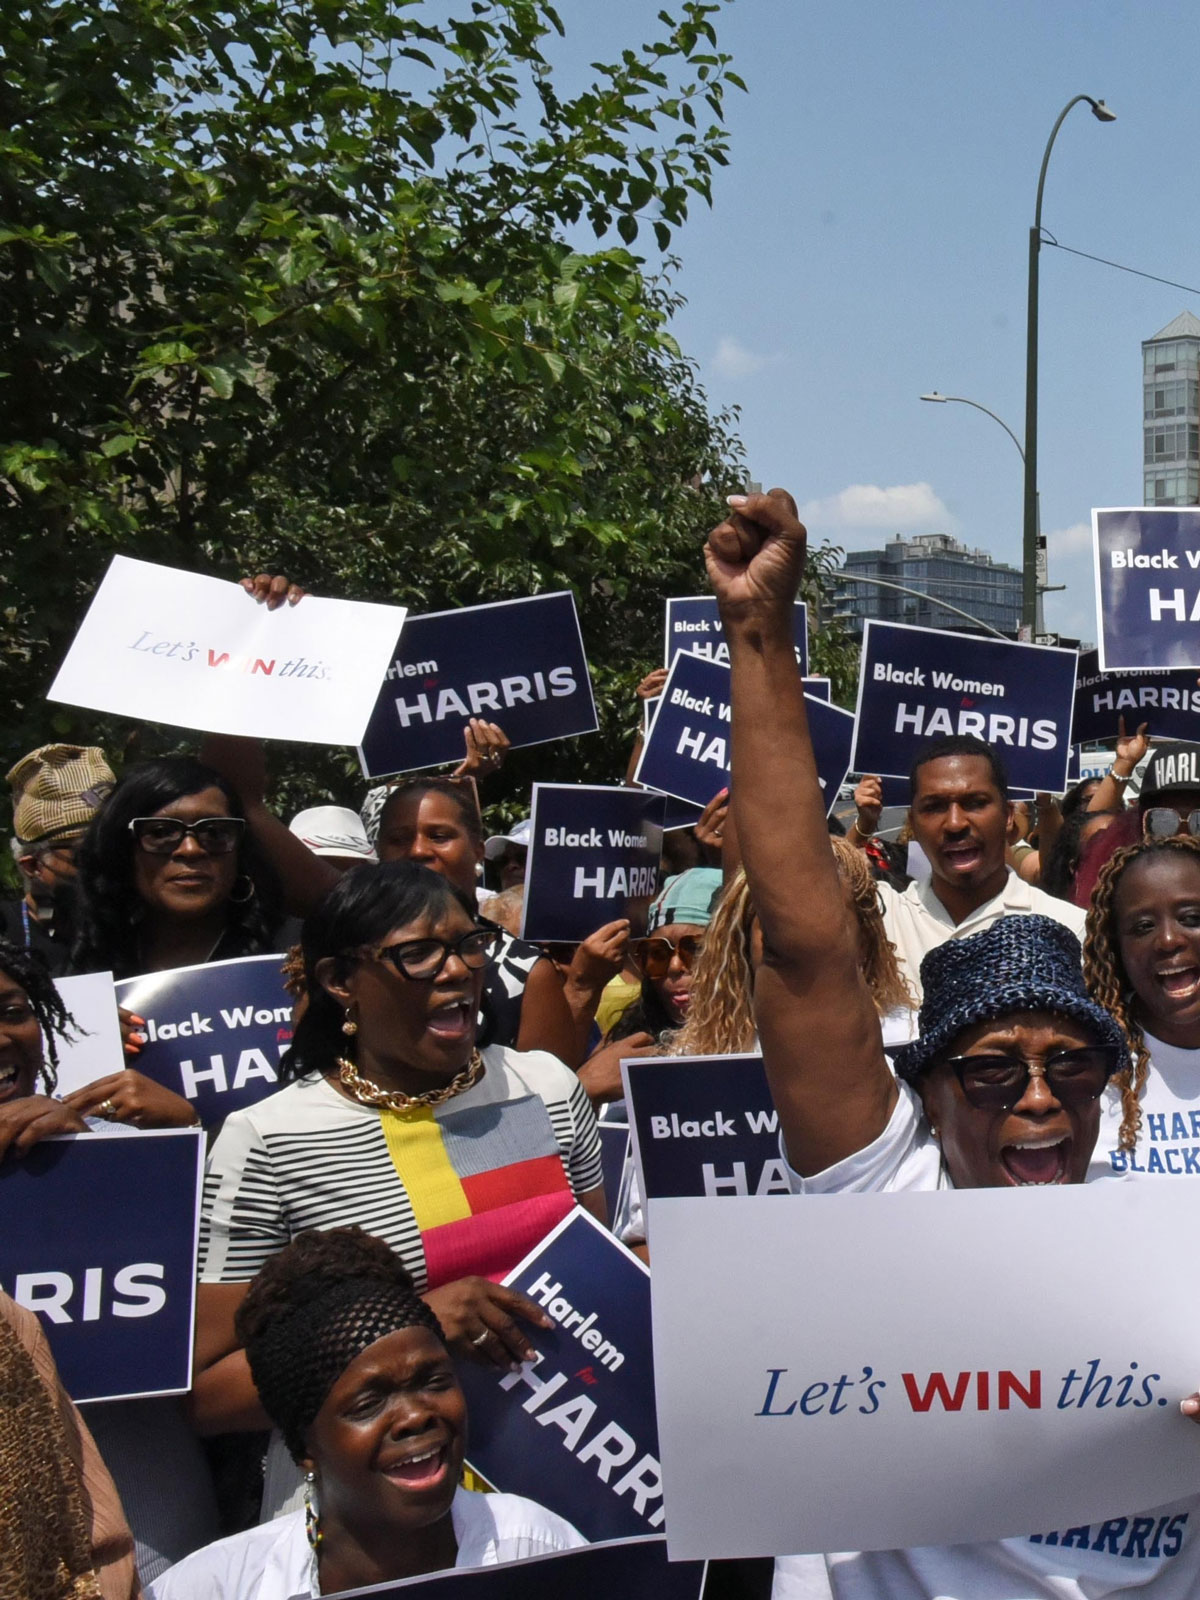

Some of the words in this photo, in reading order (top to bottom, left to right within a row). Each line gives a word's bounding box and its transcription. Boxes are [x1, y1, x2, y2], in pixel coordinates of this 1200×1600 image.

[1111, 549, 1179, 569] Black
[674, 620, 710, 633] Black
[383, 659, 439, 681] rlem
[873, 662, 926, 687] Black
[931, 671, 1005, 697] Women
[395, 666, 577, 728] HARRIS
[670, 688, 714, 716] Black
[895, 702, 1057, 750] HARRIS
[544, 827, 603, 848] Black
[573, 867, 657, 898] HARRIS
[220, 1005, 293, 1029] Wom
[651, 1110, 737, 1139] Black
[15, 1262, 167, 1324] RIS
[526, 1271, 625, 1373] Harlem
[754, 1366, 886, 1416] Let's
[901, 1370, 1041, 1413] WIN
[1057, 1359, 1168, 1409] this.
